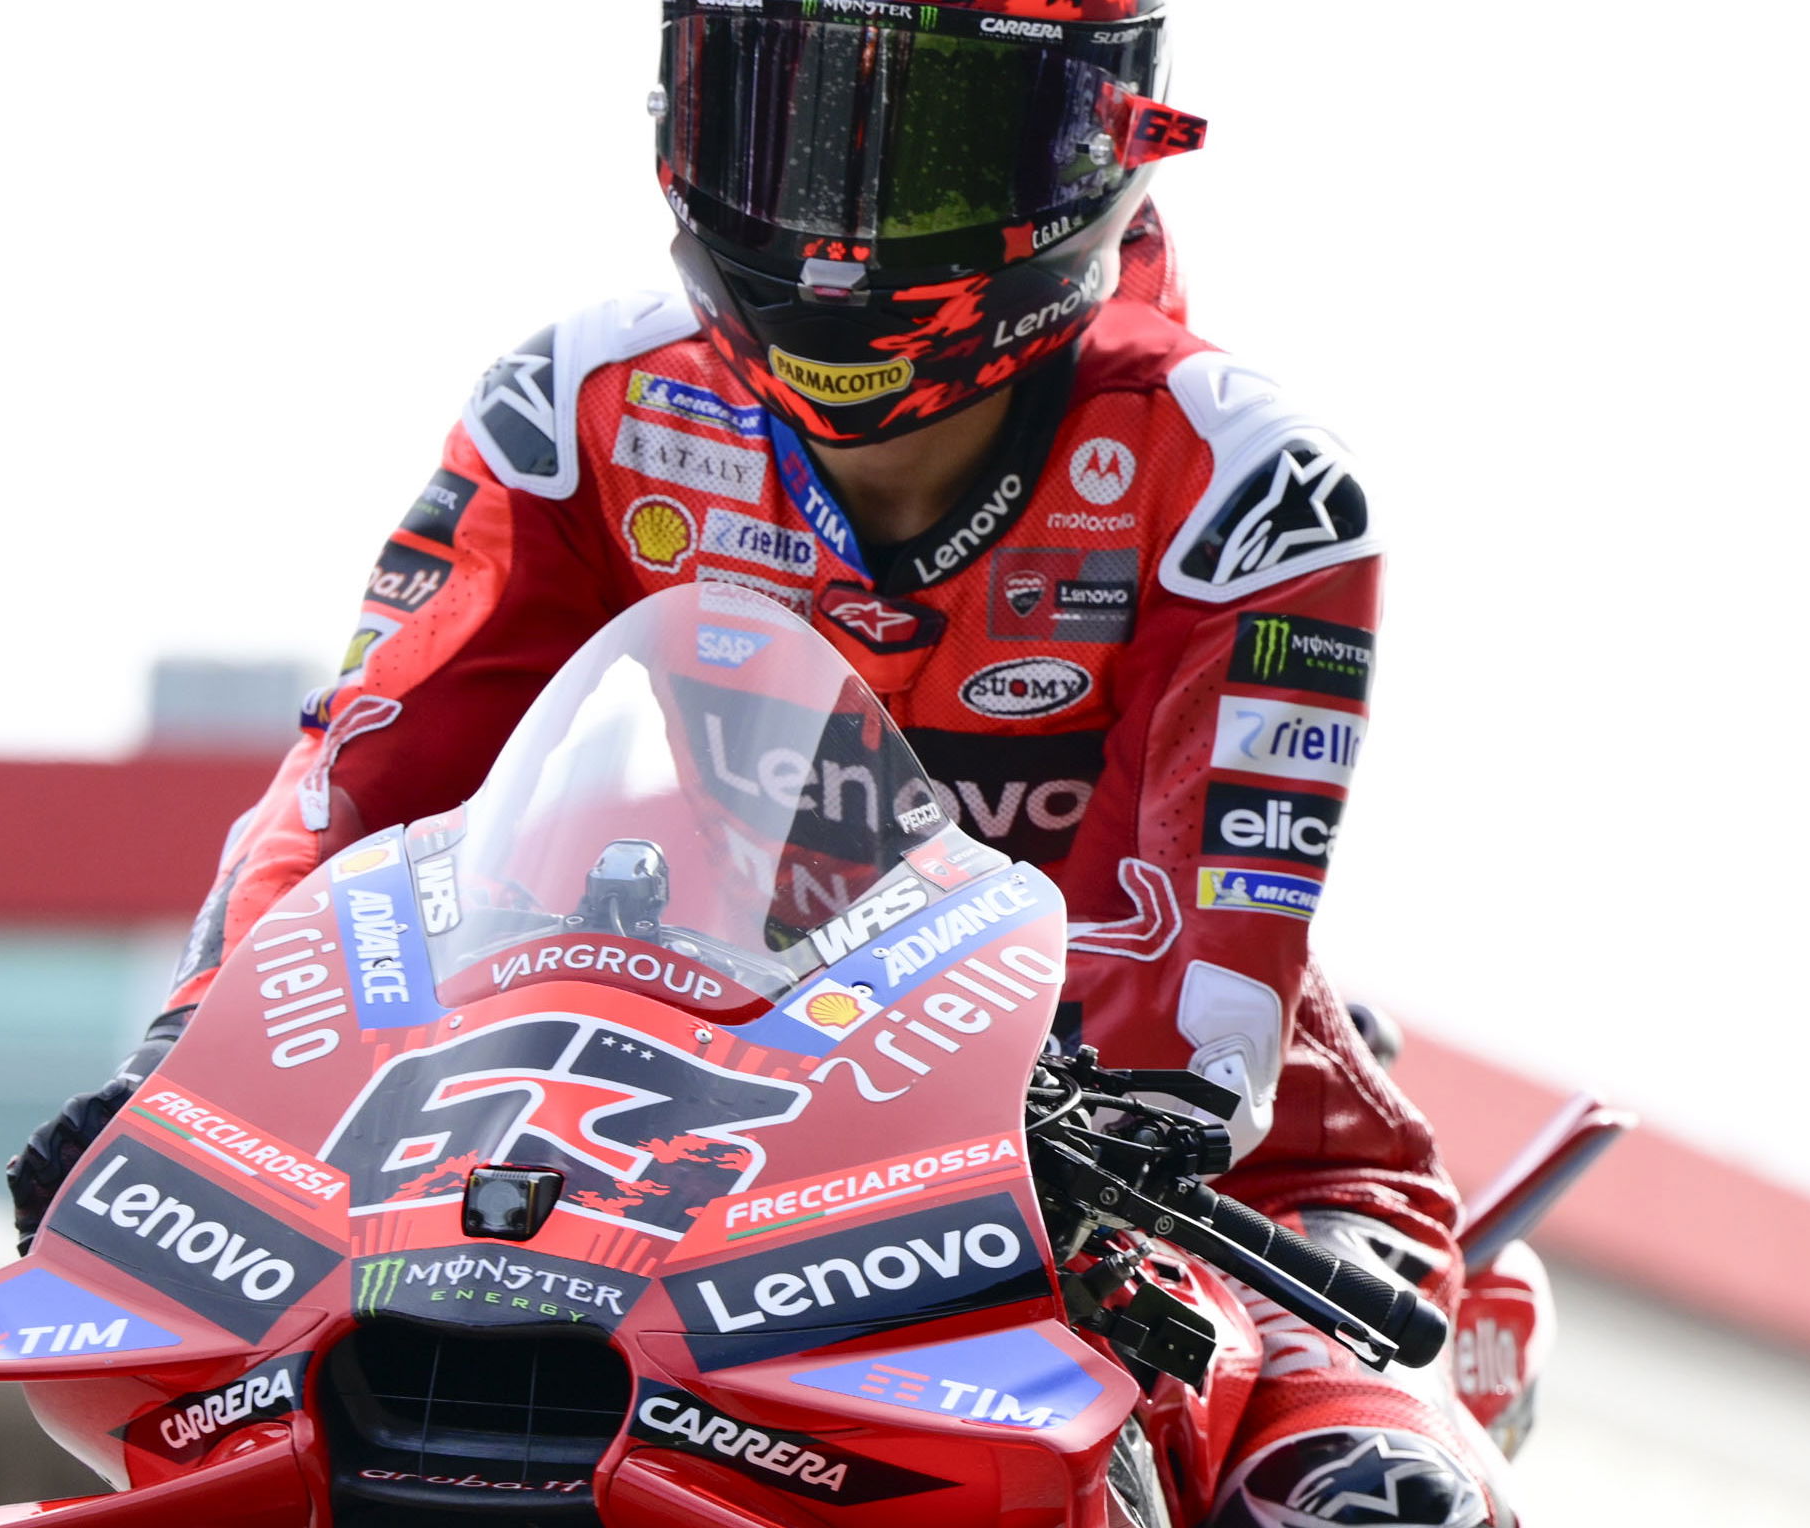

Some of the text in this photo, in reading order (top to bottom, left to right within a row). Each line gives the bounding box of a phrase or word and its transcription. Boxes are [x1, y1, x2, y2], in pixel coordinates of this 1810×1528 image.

[980, 17, 1063, 39] CARRERA
[1135, 108, 1207, 150] 63
[993, 260, 1101, 348] Lenovo
[776, 355, 903, 394] PARMACOTTO
[630, 434, 750, 484] EATALY
[738, 525, 813, 564] riello
[804, 486, 848, 554] TIM
[913, 473, 1023, 585] Lenovo
[1047, 511, 1136, 531] motorola
[1061, 586, 1128, 604] Lenovo
[697, 632, 755, 663] SAP
[974, 676, 1078, 699] SUOMY
[703, 712, 1096, 837] Lenovo
[417, 856, 459, 934] WRS
[810, 876, 927, 967] WRS
[880, 882, 1039, 987] ADVANCE
[347, 888, 410, 1004] ADVANCE
[253, 926, 348, 1069] riello
[875, 945, 1064, 1077] riello
[143, 1090, 347, 1201] FRECCIAROSSA
[317, 1010, 812, 1243] 63
[726, 1139, 1019, 1229] FRECCIAROSSA
[75, 1154, 295, 1301] Lenovo
[405, 1254, 626, 1315] MONSTER
[431, 1289, 589, 1323] ENERGY
[697, 1222, 1021, 1333] Lenovo
[18, 1318, 128, 1354] TIM
[159, 1367, 295, 1449] CARRERA
[939, 1379, 1057, 1427] TIM
[638, 1396, 848, 1492] CARRERA
